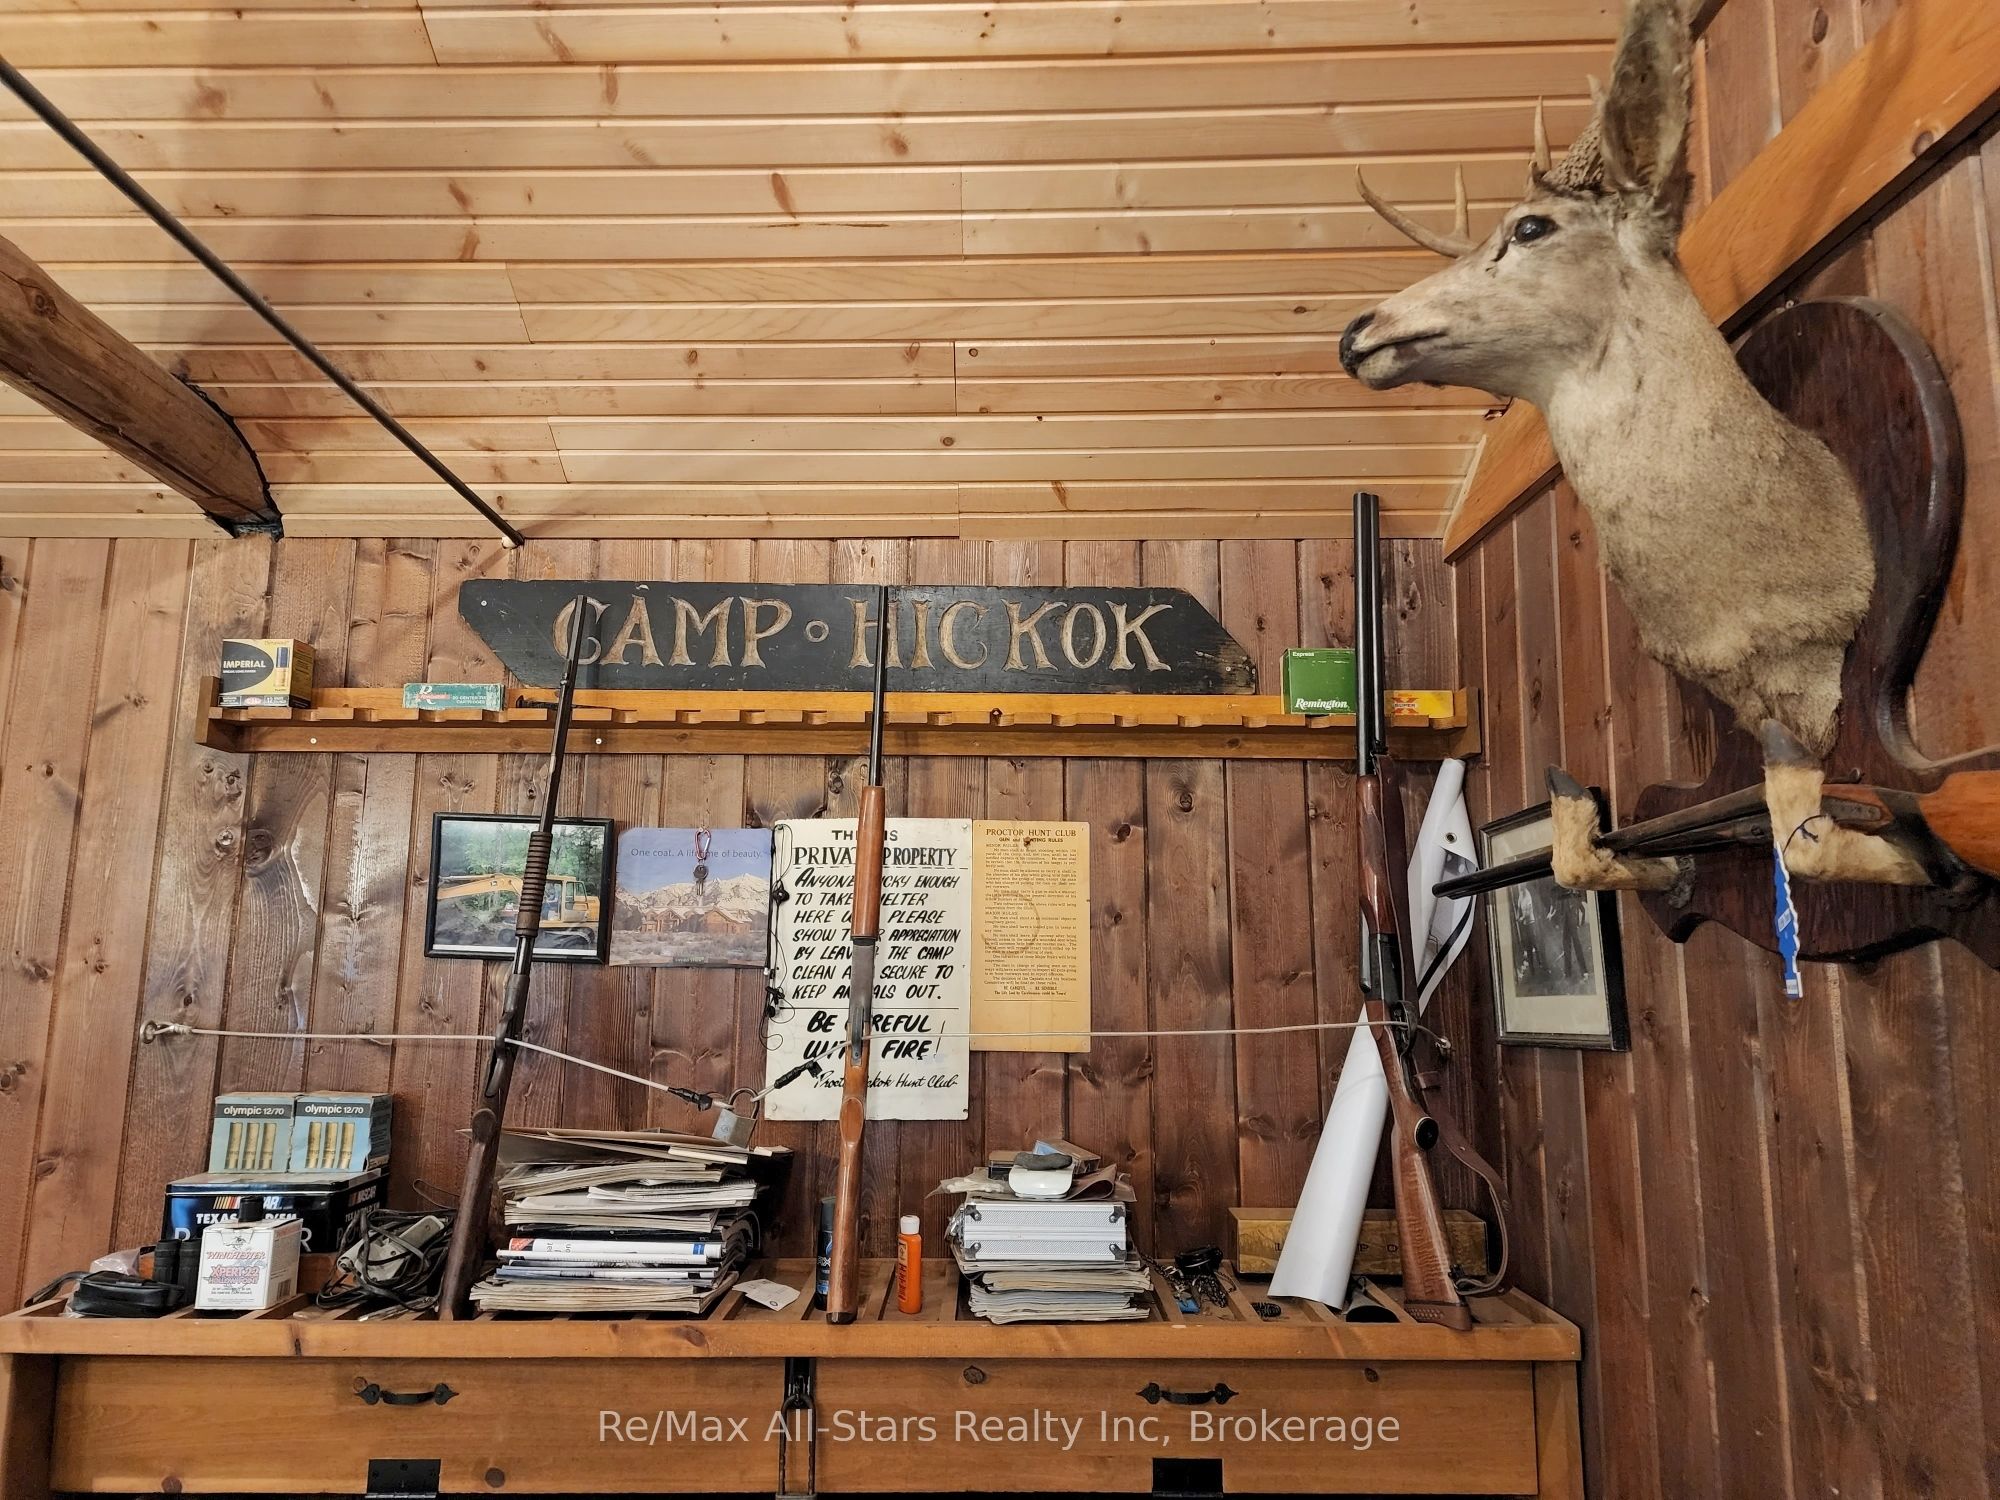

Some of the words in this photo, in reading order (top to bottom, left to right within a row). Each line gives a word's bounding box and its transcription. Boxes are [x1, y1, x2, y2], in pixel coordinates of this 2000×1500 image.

[553, 594, 791, 667] CAMP
[844, 596, 1172, 671] HICKOK
[223, 660, 266, 668] IMPERIAL
[1295, 697, 1349, 710] Remington
[986, 828, 1024, 836] PROCTOR
[1055, 829, 1077, 837] CLUB
[631, 848, 650, 857] One
[677, 849, 684, 857] A
[721, 849, 731, 858] of
[793, 846, 857, 866] PRIVA
[882, 846, 957, 867] PROPERTY
[914, 875, 960, 889] ENOUGH
[795, 892, 813, 906] TO
[819, 892, 853, 906] TAKE
[793, 909, 836, 924] HERE
[887, 909, 947, 924] PLEASE
[792, 928, 837, 943] SHOW
[888, 928, 961, 943] APPRECIATION
[794, 946, 815, 960] BY
[887, 945, 912, 960] THE
[917, 945, 954, 960] CAMP
[792, 964, 836, 980] CLEAN
[879, 964, 928, 980] SECURE
[934, 964, 954, 980] TO
[792, 984, 827, 1000] KEEP
[905, 984, 942, 1000] OUT.
[807, 1010, 838, 1033] BE
[894, 1072, 926, 1089] Hunt
[926, 1074, 958, 1089] Club
[224, 1105, 261, 1117] olympic
[263, 1107, 285, 1115] 12/70
[305, 1104, 342, 1115] olympic
[344, 1106, 364, 1114] 12/70
[206, 1251, 266, 1260] WINCHESTER
